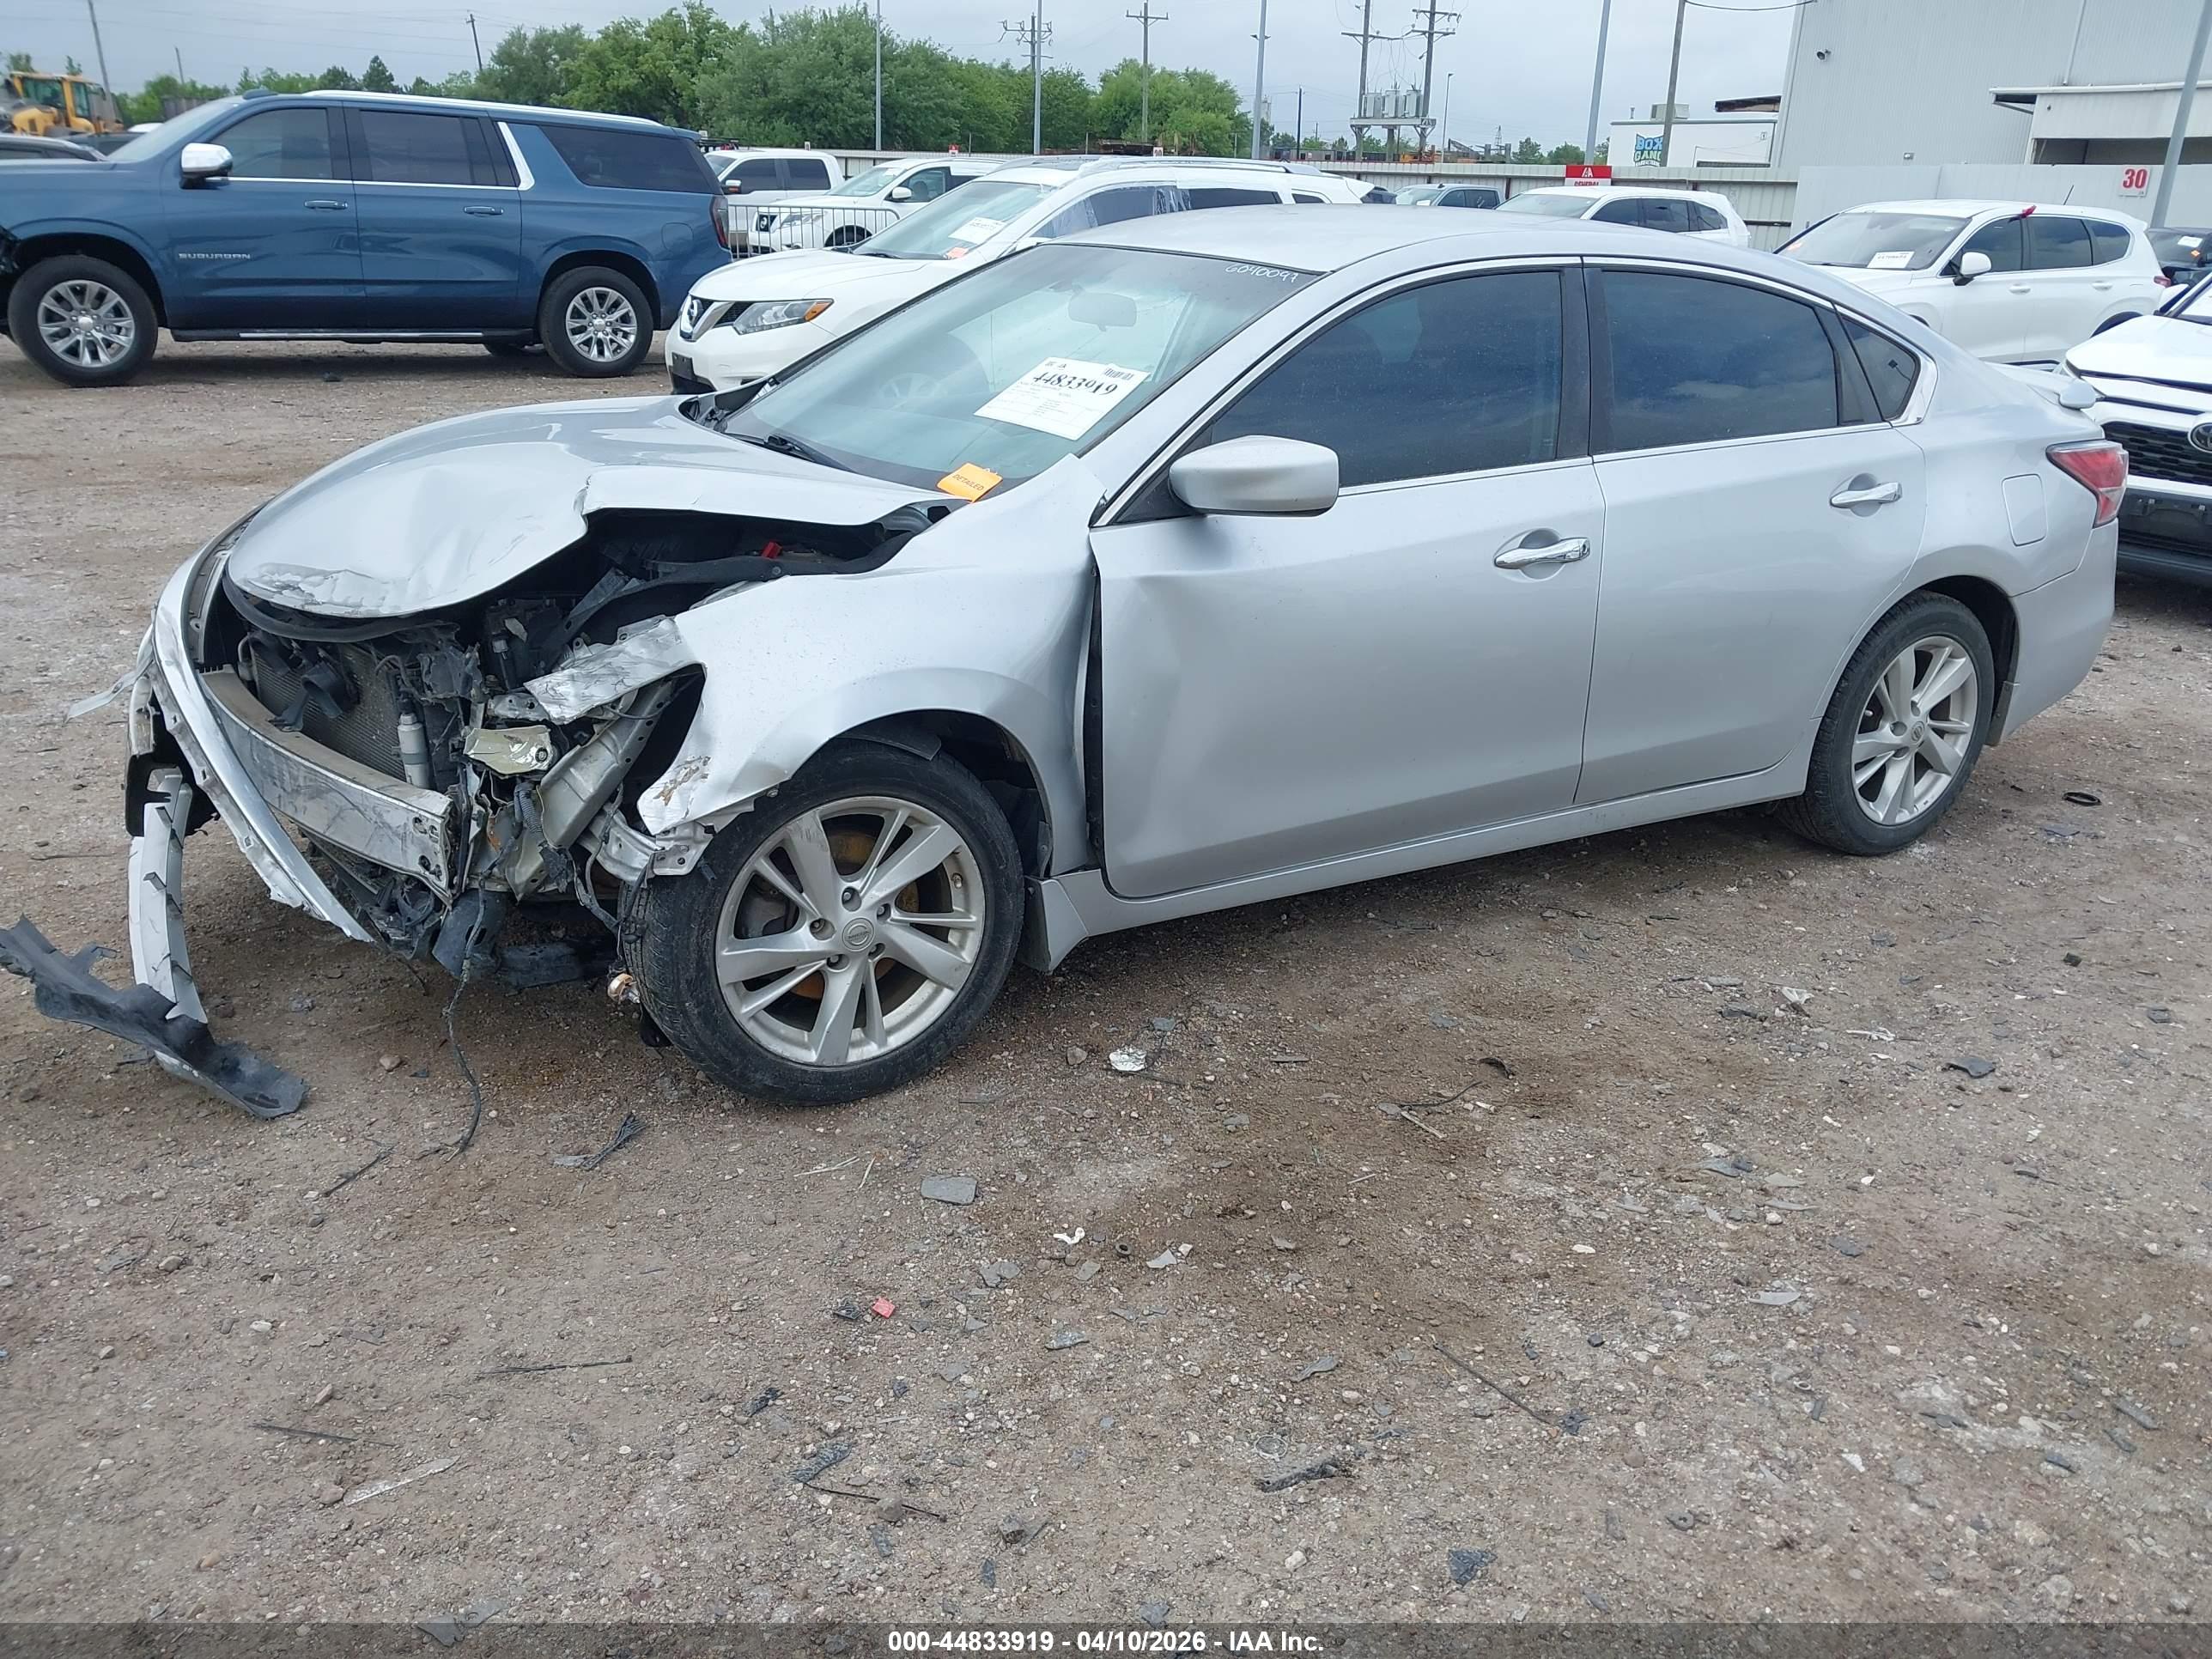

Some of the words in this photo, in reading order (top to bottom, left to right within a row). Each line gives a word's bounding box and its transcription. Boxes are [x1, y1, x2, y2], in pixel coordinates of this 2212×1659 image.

[1635, 135, 1663, 150] BOX
[2123, 168, 2148, 189] 30
[952, 474, 984, 491] DETAILED
